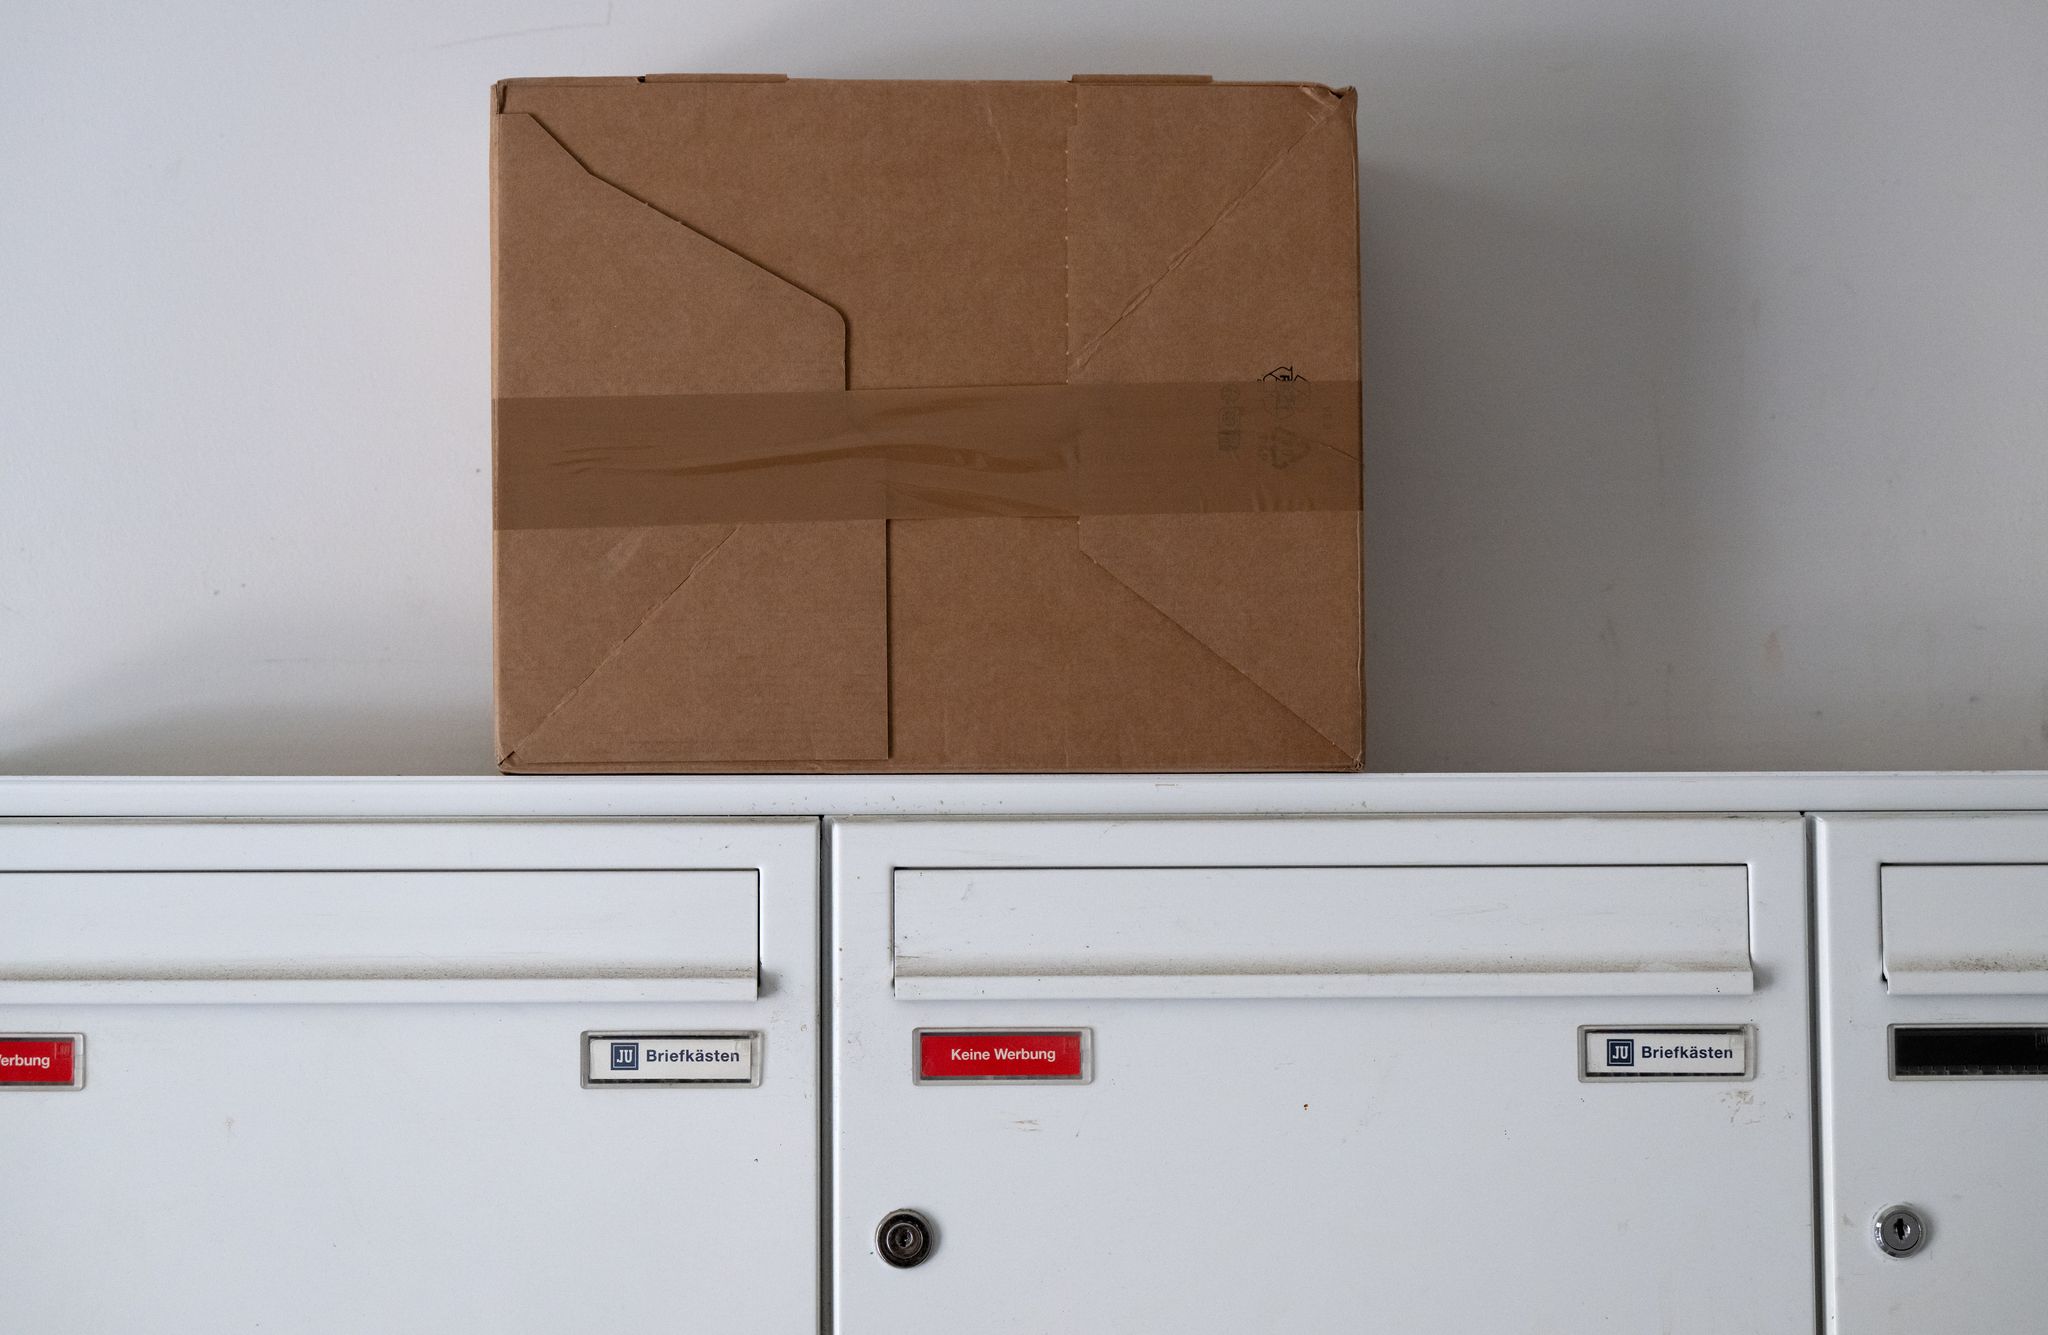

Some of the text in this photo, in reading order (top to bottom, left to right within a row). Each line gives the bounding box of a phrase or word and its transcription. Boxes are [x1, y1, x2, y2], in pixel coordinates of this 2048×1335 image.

[616, 1049, 740, 1063] JU Briefkästen
[951, 1047, 1056, 1062] Keine Werbung
[1612, 1045, 1733, 1059] JU Briefkästen
[0, 1054, 50, 1069] erbung
